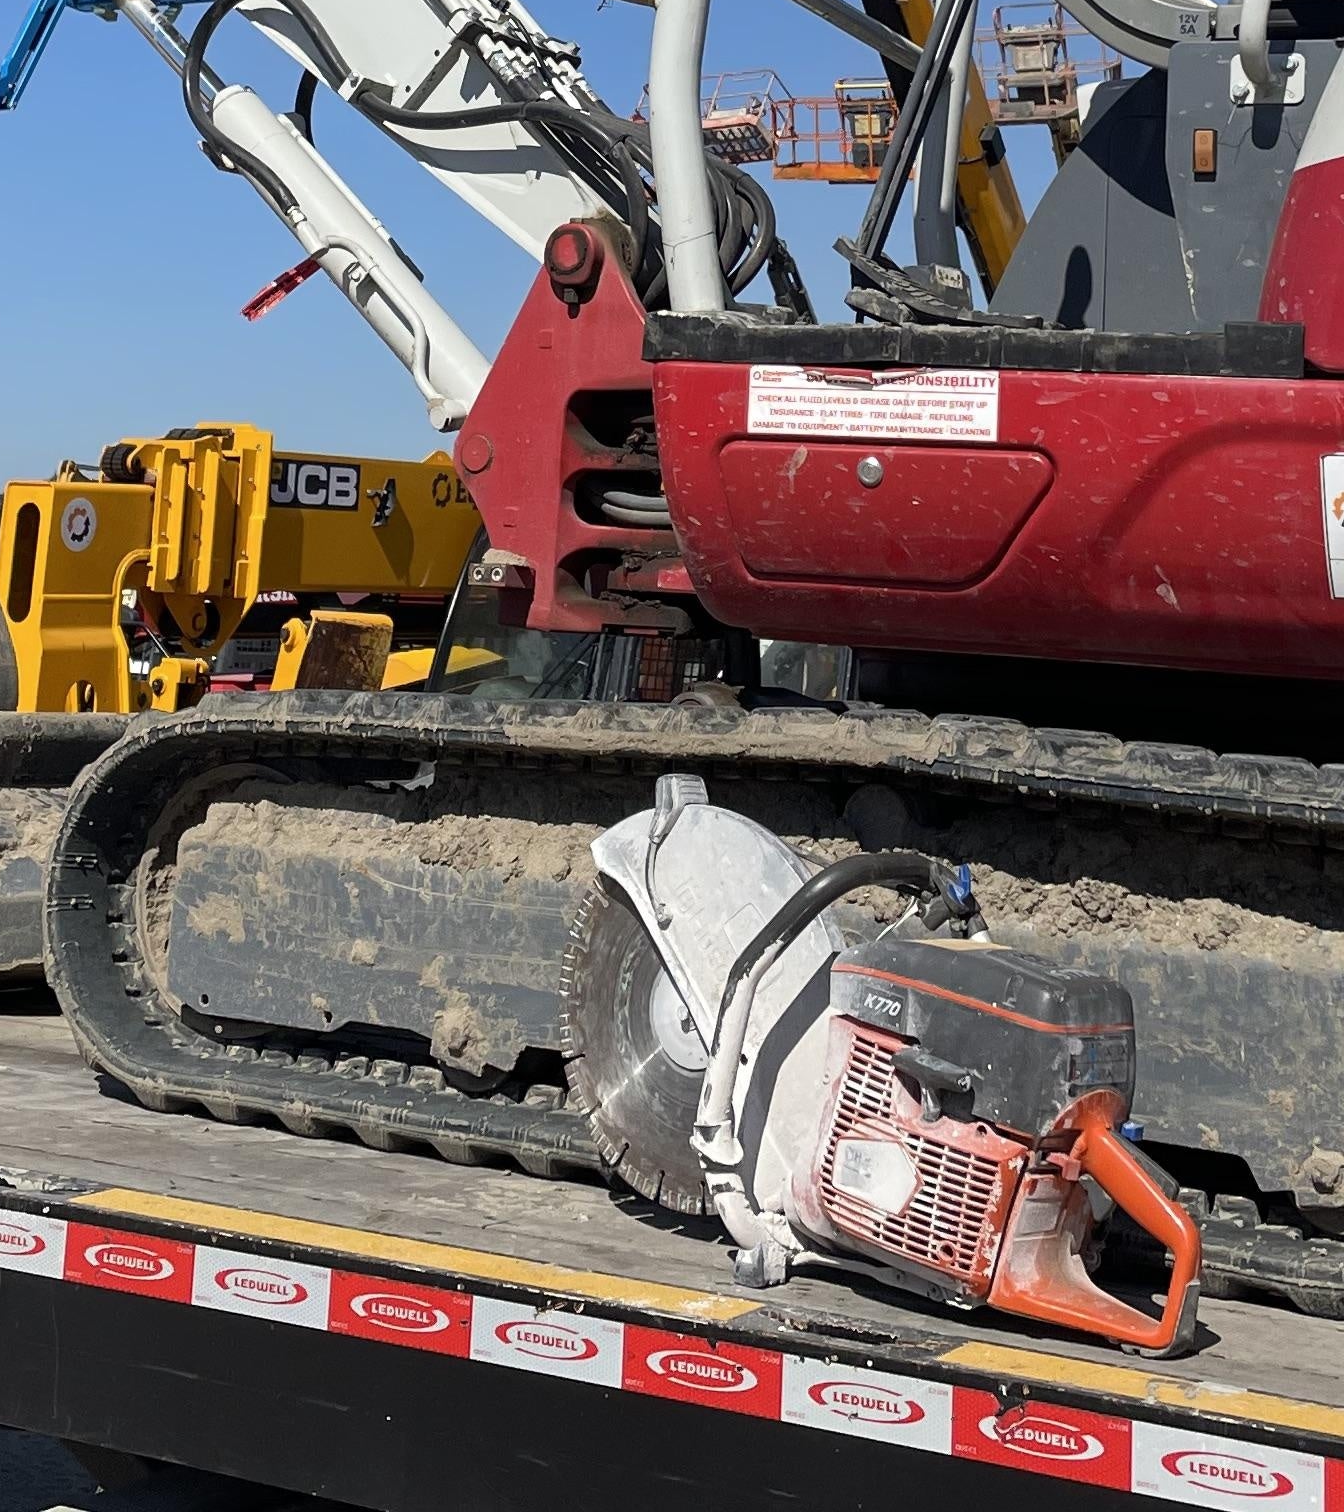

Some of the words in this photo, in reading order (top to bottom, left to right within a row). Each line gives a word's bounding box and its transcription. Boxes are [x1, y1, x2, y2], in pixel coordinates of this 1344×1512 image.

[1178, 14, 1199, 24] 12V
[1180, 24, 1196, 34] 5A
[783, 395, 797, 403] ALL
[270, 463, 358, 507] JCB
[863, 992, 902, 1017] K770
[102, 1251, 156, 1272] LEDWELL
[234, 1276, 289, 1297] LEDWELL
[370, 1302, 430, 1324] LEDWELL
[517, 1329, 578, 1353] LEDWELL
[668, 1360, 735, 1383] LEDWELL
[832, 1390, 902, 1414] LEDWELL
[1189, 1461, 1266, 1487] LEDWELL
